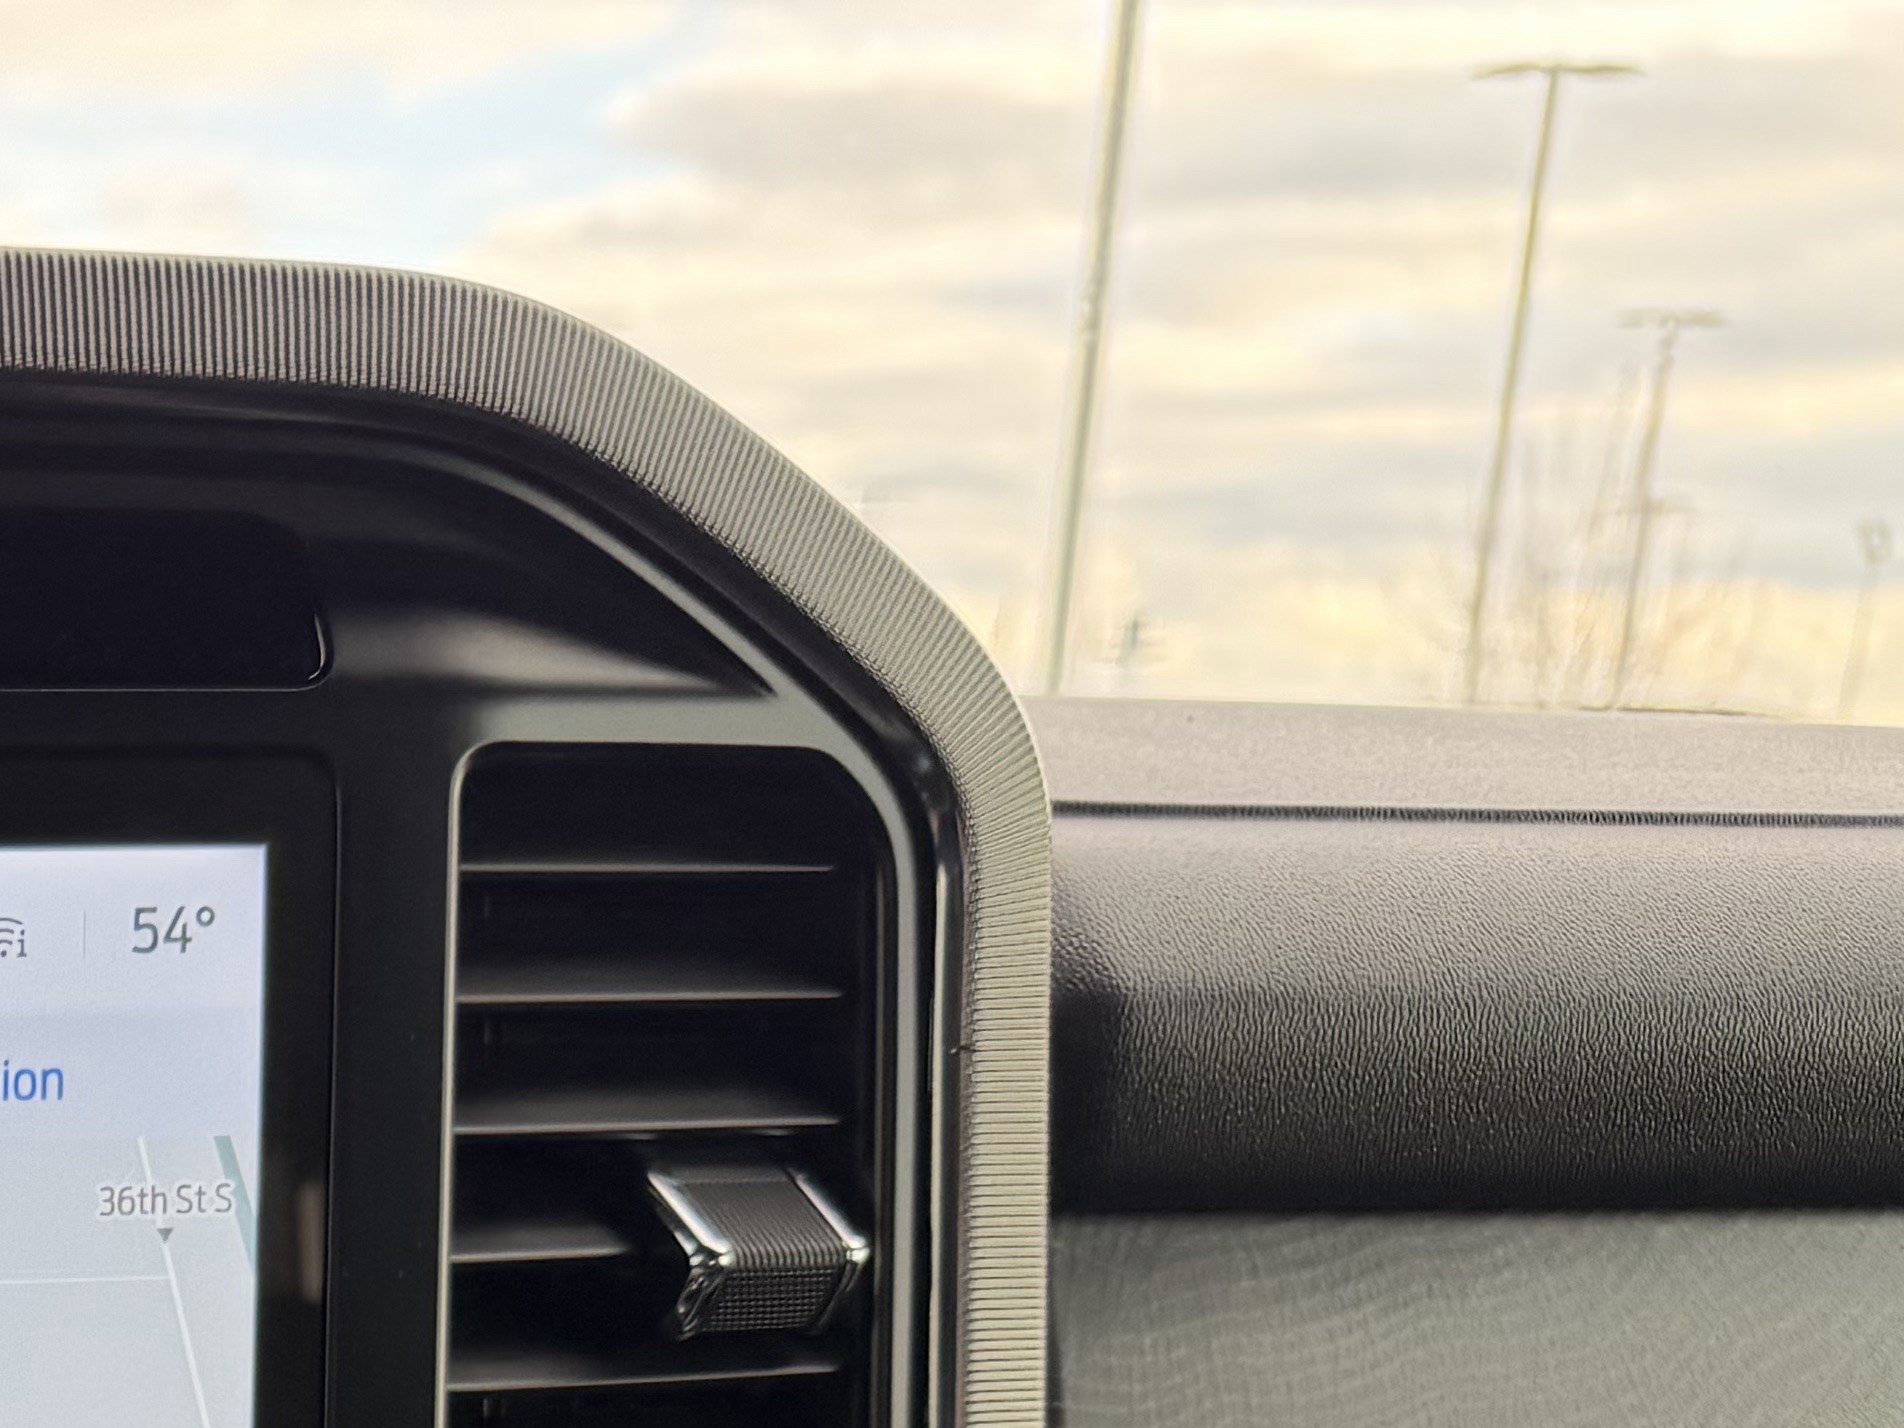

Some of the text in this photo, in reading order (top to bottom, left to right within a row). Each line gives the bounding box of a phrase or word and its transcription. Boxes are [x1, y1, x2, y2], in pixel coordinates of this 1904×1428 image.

[98, 1183, 233, 1217] 36th St S
